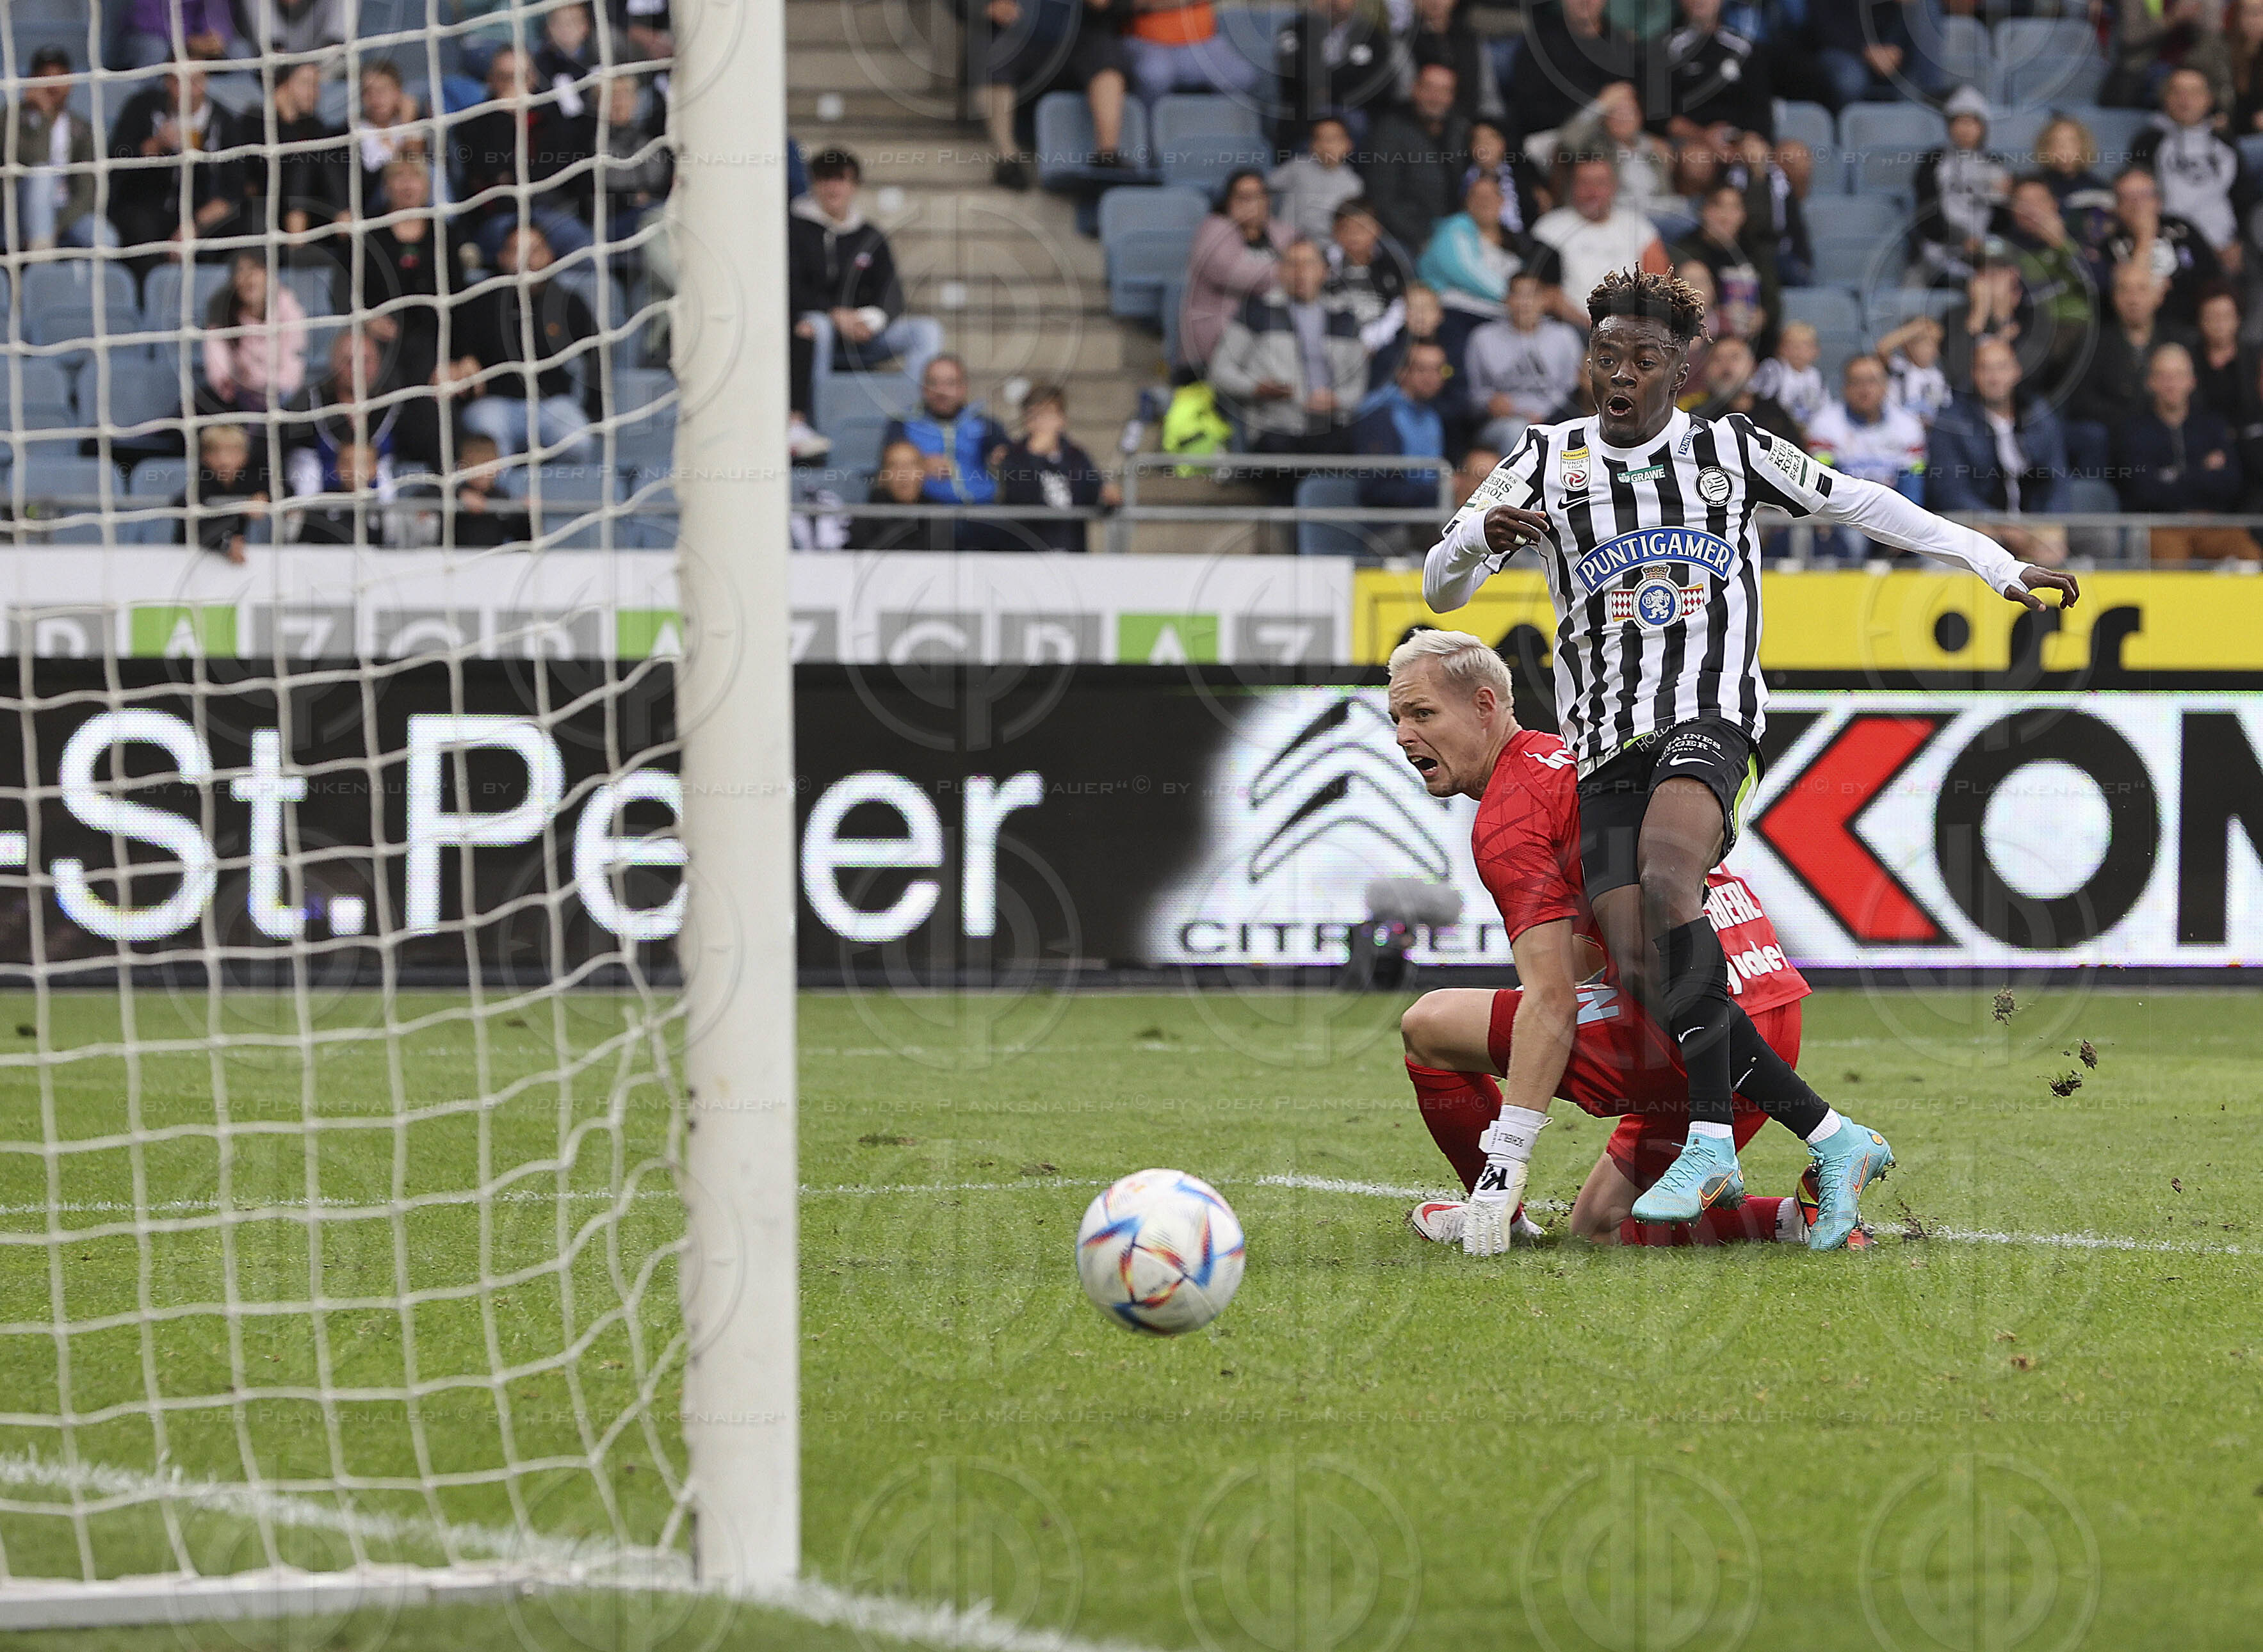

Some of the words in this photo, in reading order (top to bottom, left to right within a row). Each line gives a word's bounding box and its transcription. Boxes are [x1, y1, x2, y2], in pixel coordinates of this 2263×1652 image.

[1631, 468, 1665, 482] GRAWE
[1580, 532, 1730, 587] PUNTIGAMER
[1703, 880, 1764, 933] HIERL
